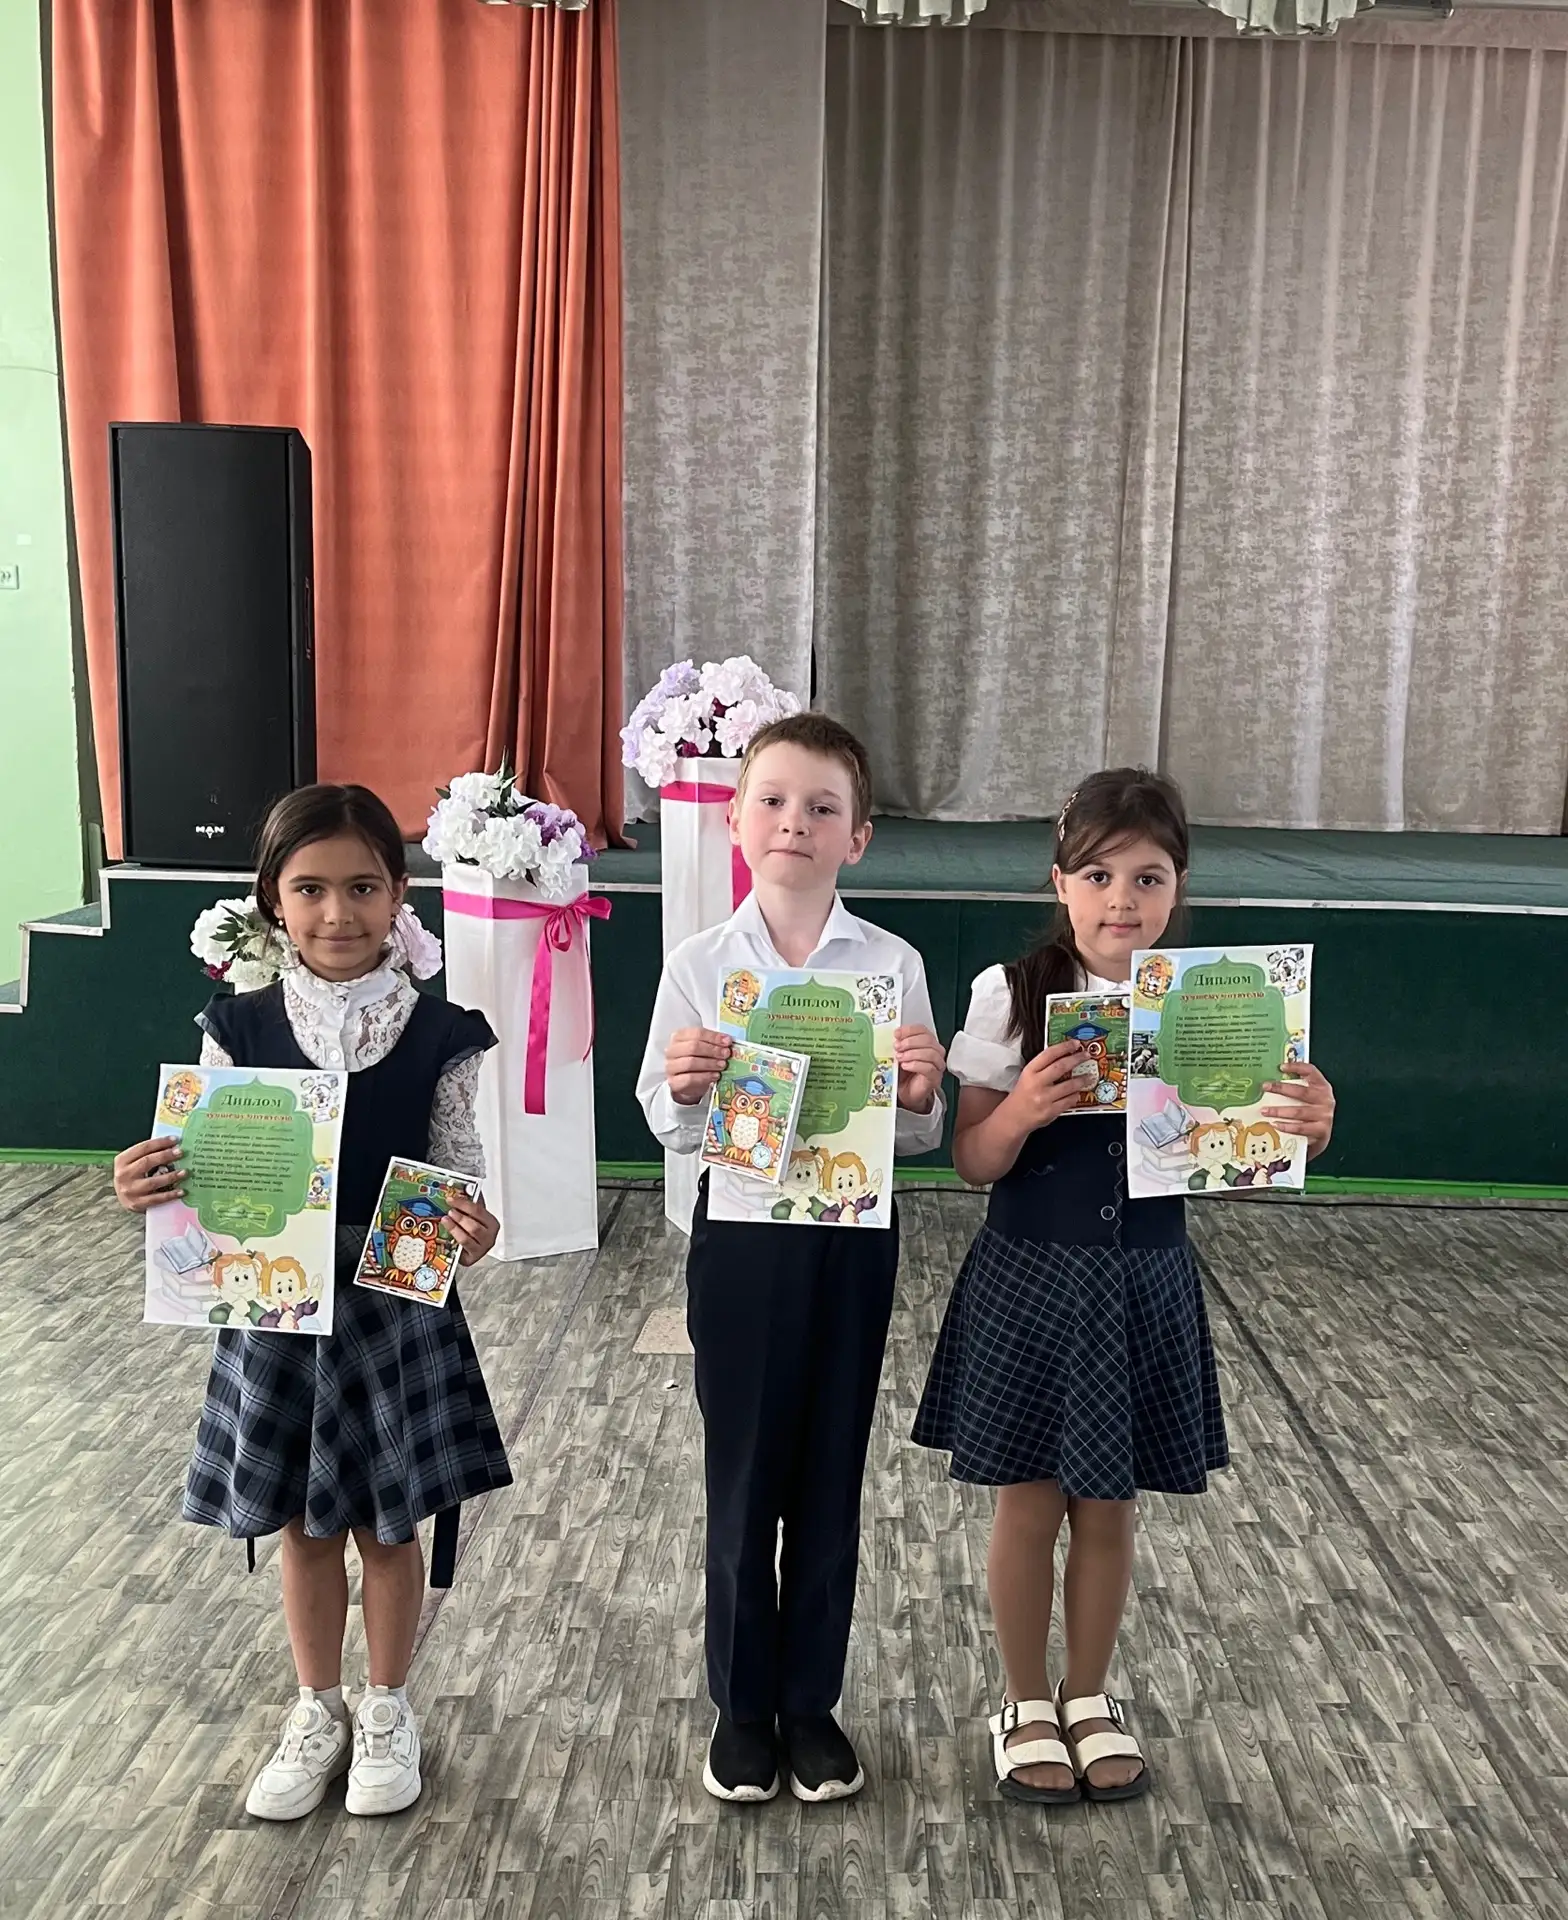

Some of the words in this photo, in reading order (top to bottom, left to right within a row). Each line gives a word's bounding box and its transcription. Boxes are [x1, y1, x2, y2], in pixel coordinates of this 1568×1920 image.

[1194, 974, 1251, 987] Диплом
[781, 994, 840, 1009] Диплом
[221, 1094, 281, 1107] Диплом
